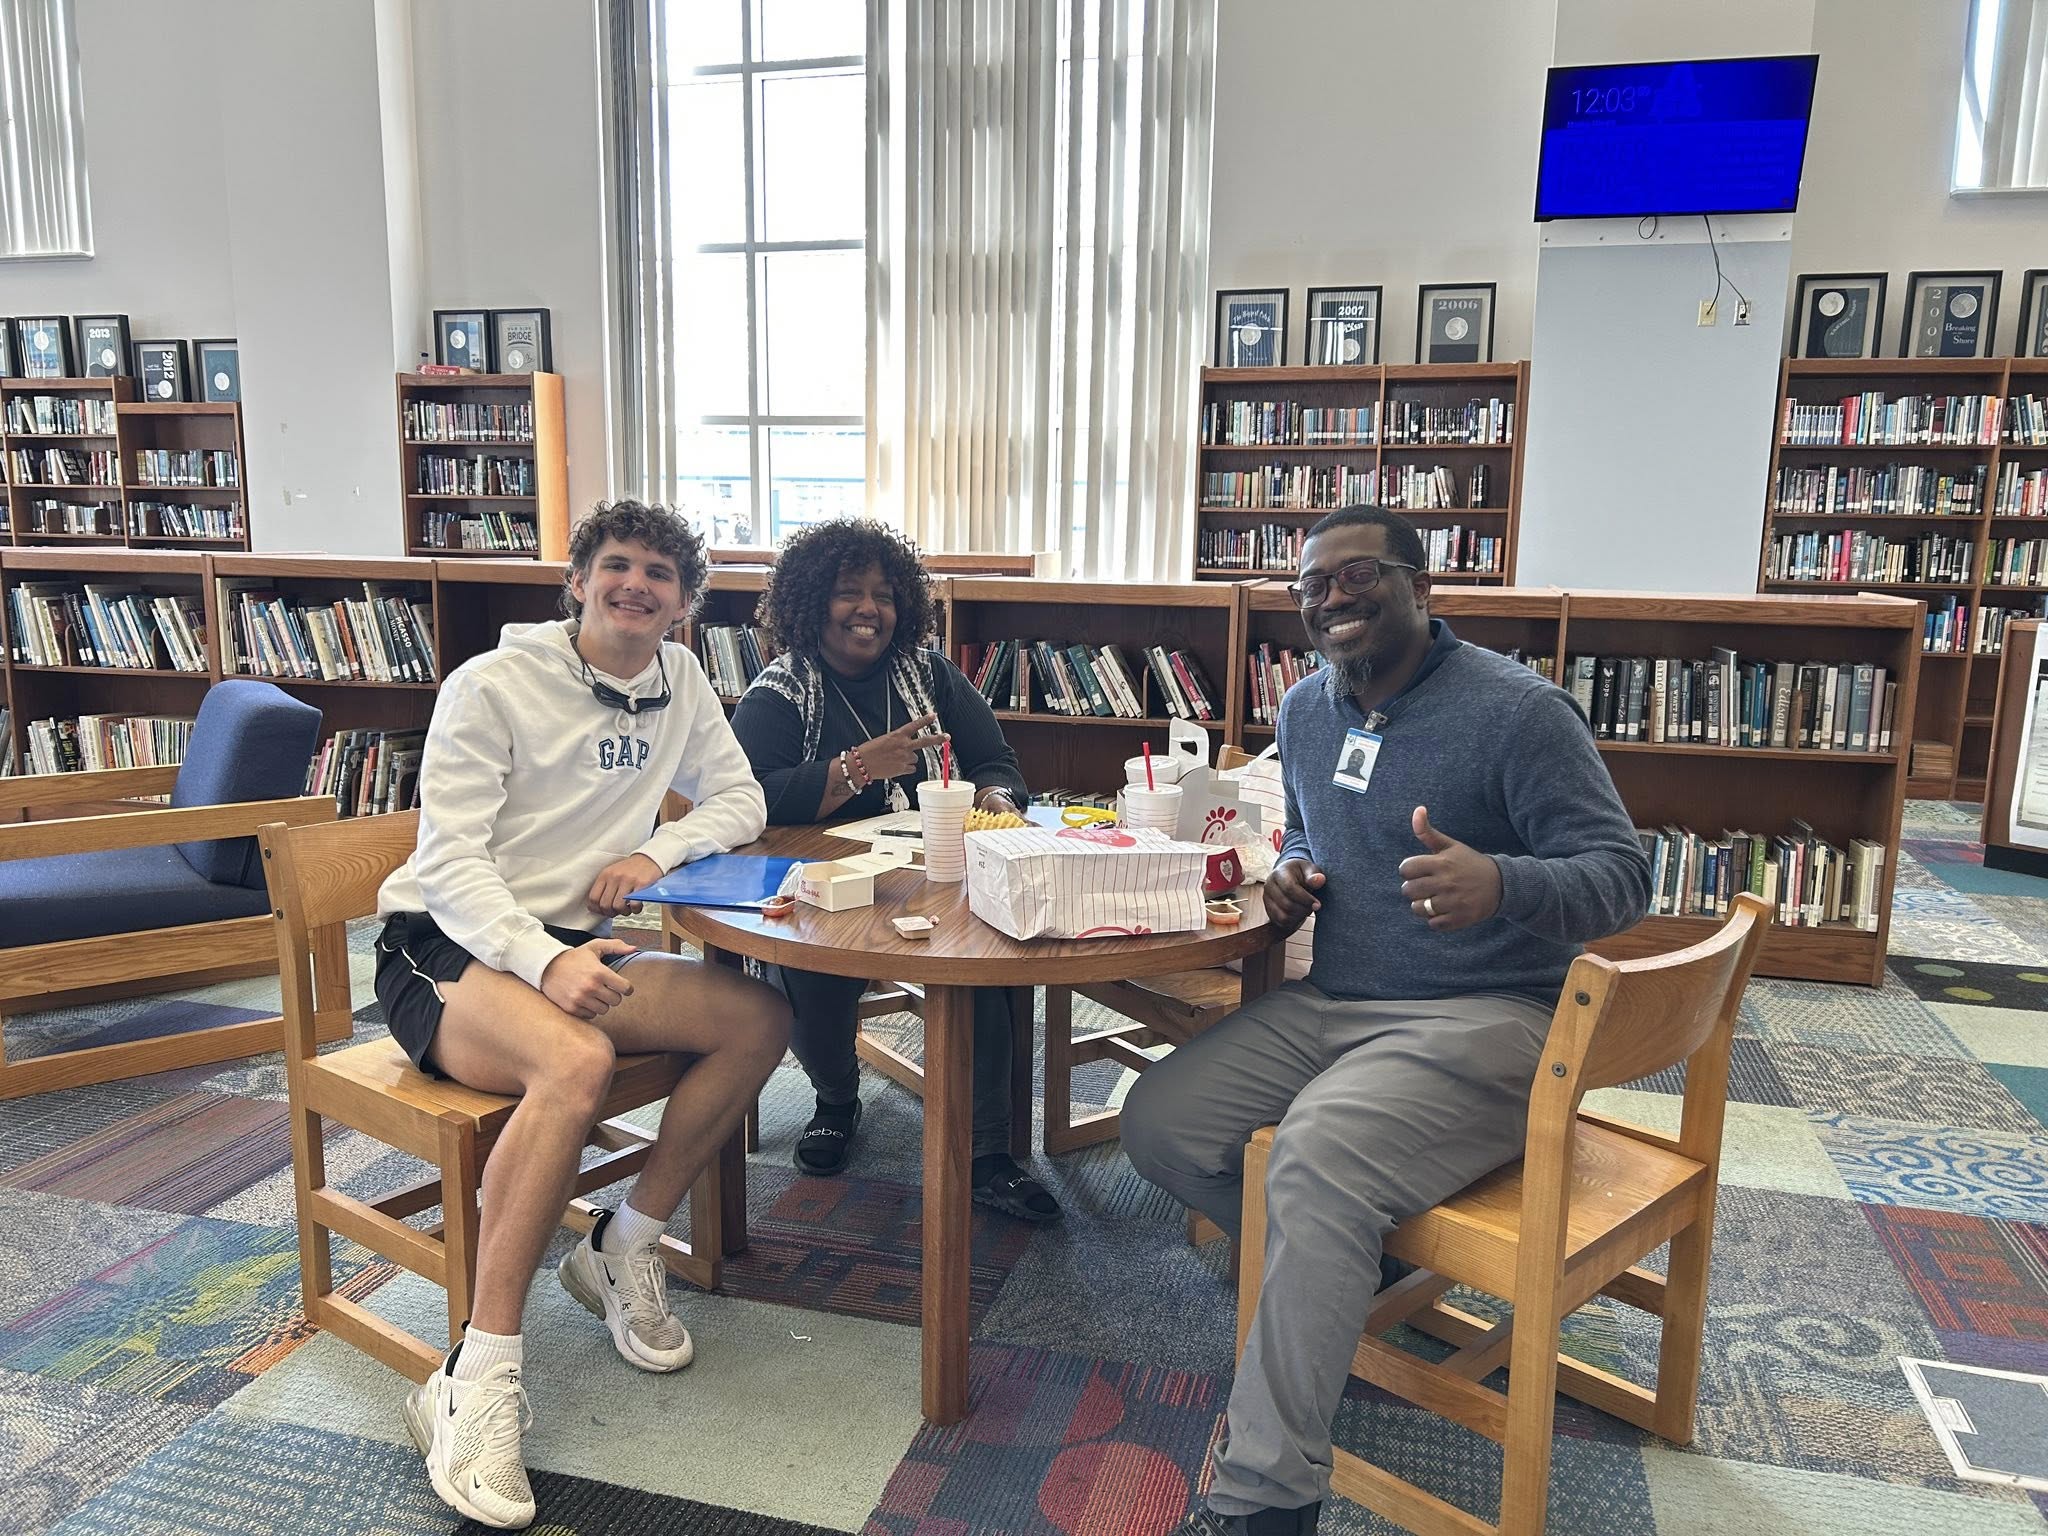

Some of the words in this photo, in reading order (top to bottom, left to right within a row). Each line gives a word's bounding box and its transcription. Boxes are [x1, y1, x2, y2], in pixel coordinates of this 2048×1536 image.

[1571, 86, 1637, 115] 12:03
[1338, 305, 1365, 316] 2007
[1438, 300, 1479, 310] 2006
[88, 327, 111, 339] 2013
[507, 331, 532, 342] BRIDGE
[1945, 322, 1977, 332] Breaking
[1952, 334, 1975, 344] Shore
[162, 351, 175, 380] 2012
[388, 618, 400, 643] MONET
[395, 616, 412, 648] PICASSO
[1603, 678, 1612, 698] hope
[1655, 661, 1665, 708] amelia
[1671, 688, 1679, 713] WYATT
[1776, 687, 1791, 728] Edison
[598, 735, 650, 770] GAP
[1755, 855, 1765, 886] MASTER
